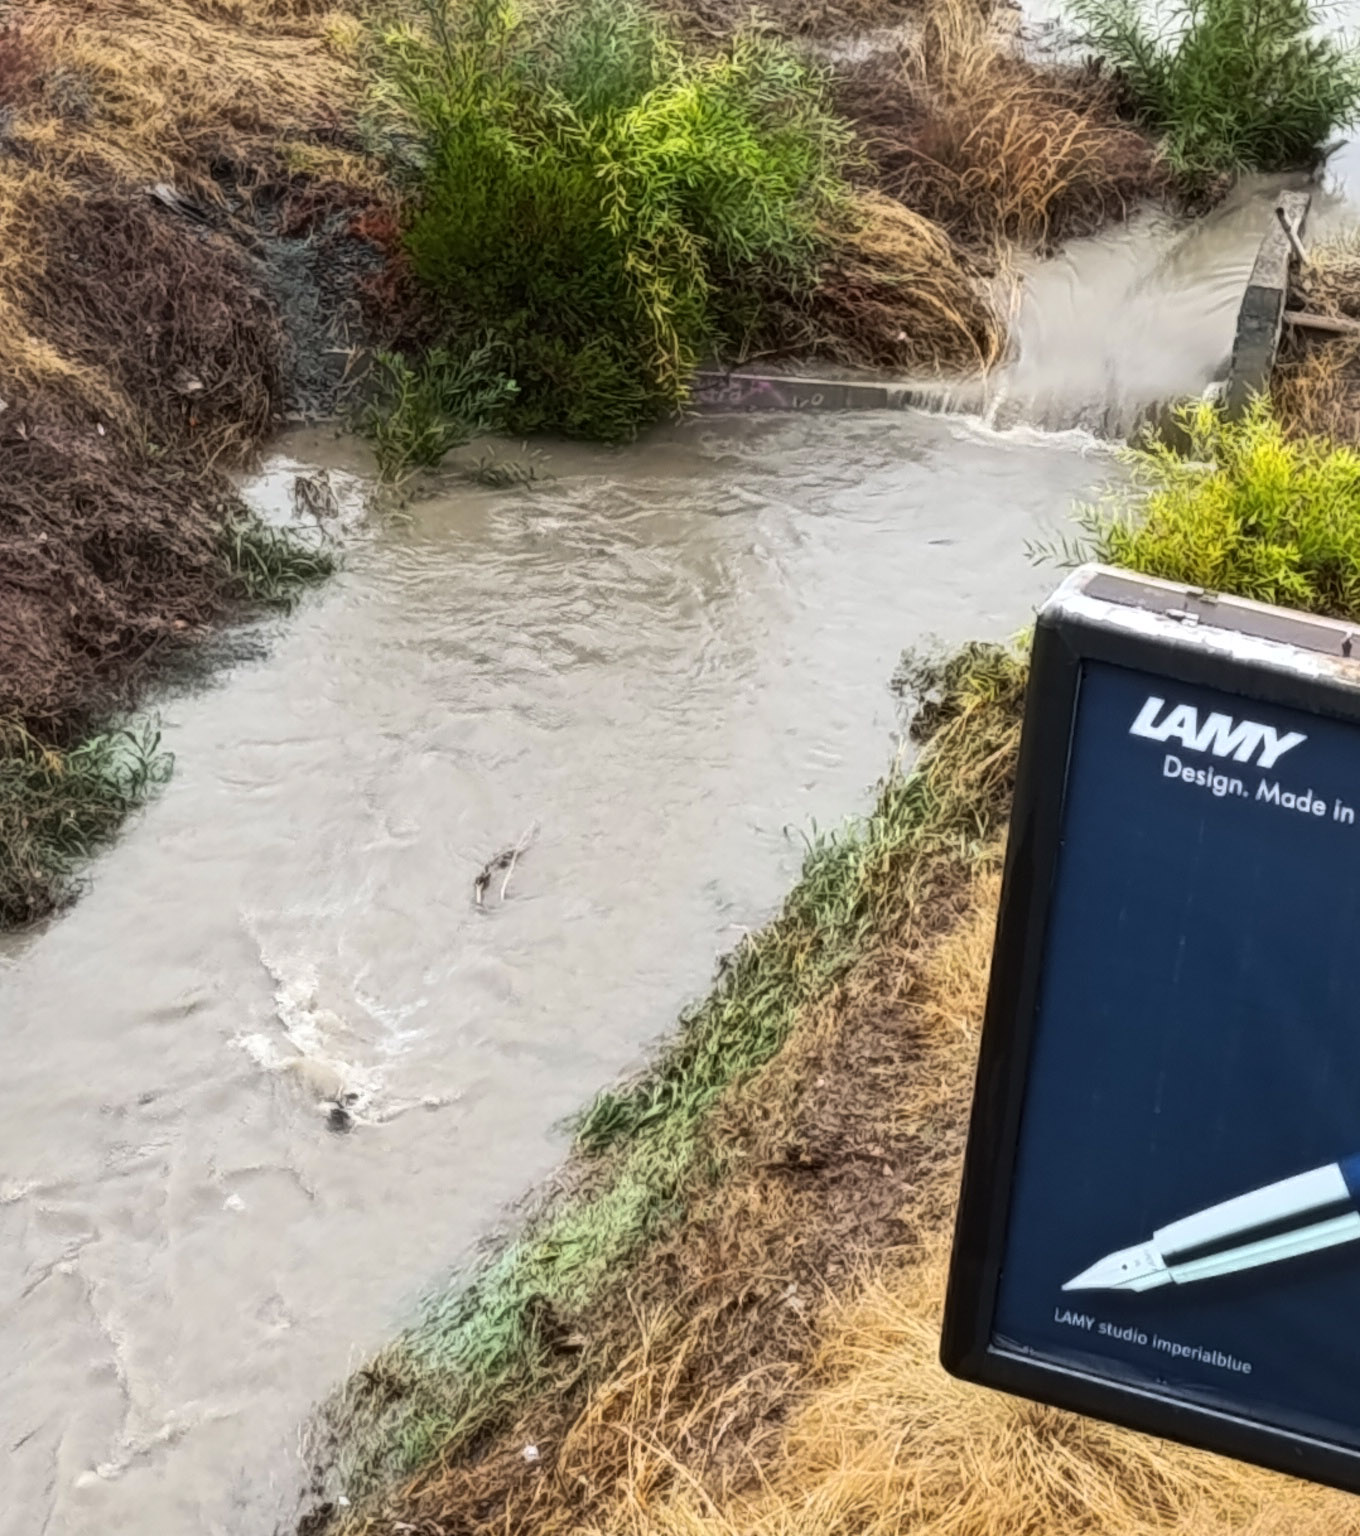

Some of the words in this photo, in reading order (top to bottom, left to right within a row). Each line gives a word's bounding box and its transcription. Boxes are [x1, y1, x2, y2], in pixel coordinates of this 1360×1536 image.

[1129, 695, 1308, 769] LAMY
[1162, 754, 1250, 797] Design.
[1255, 778, 1327, 816] Made
[1332, 798, 1356, 825] in
[1054, 1307, 1095, 1331] LAMY
[1098, 1321, 1148, 1345] studio
[1152, 1334, 1253, 1374] imperialblue
